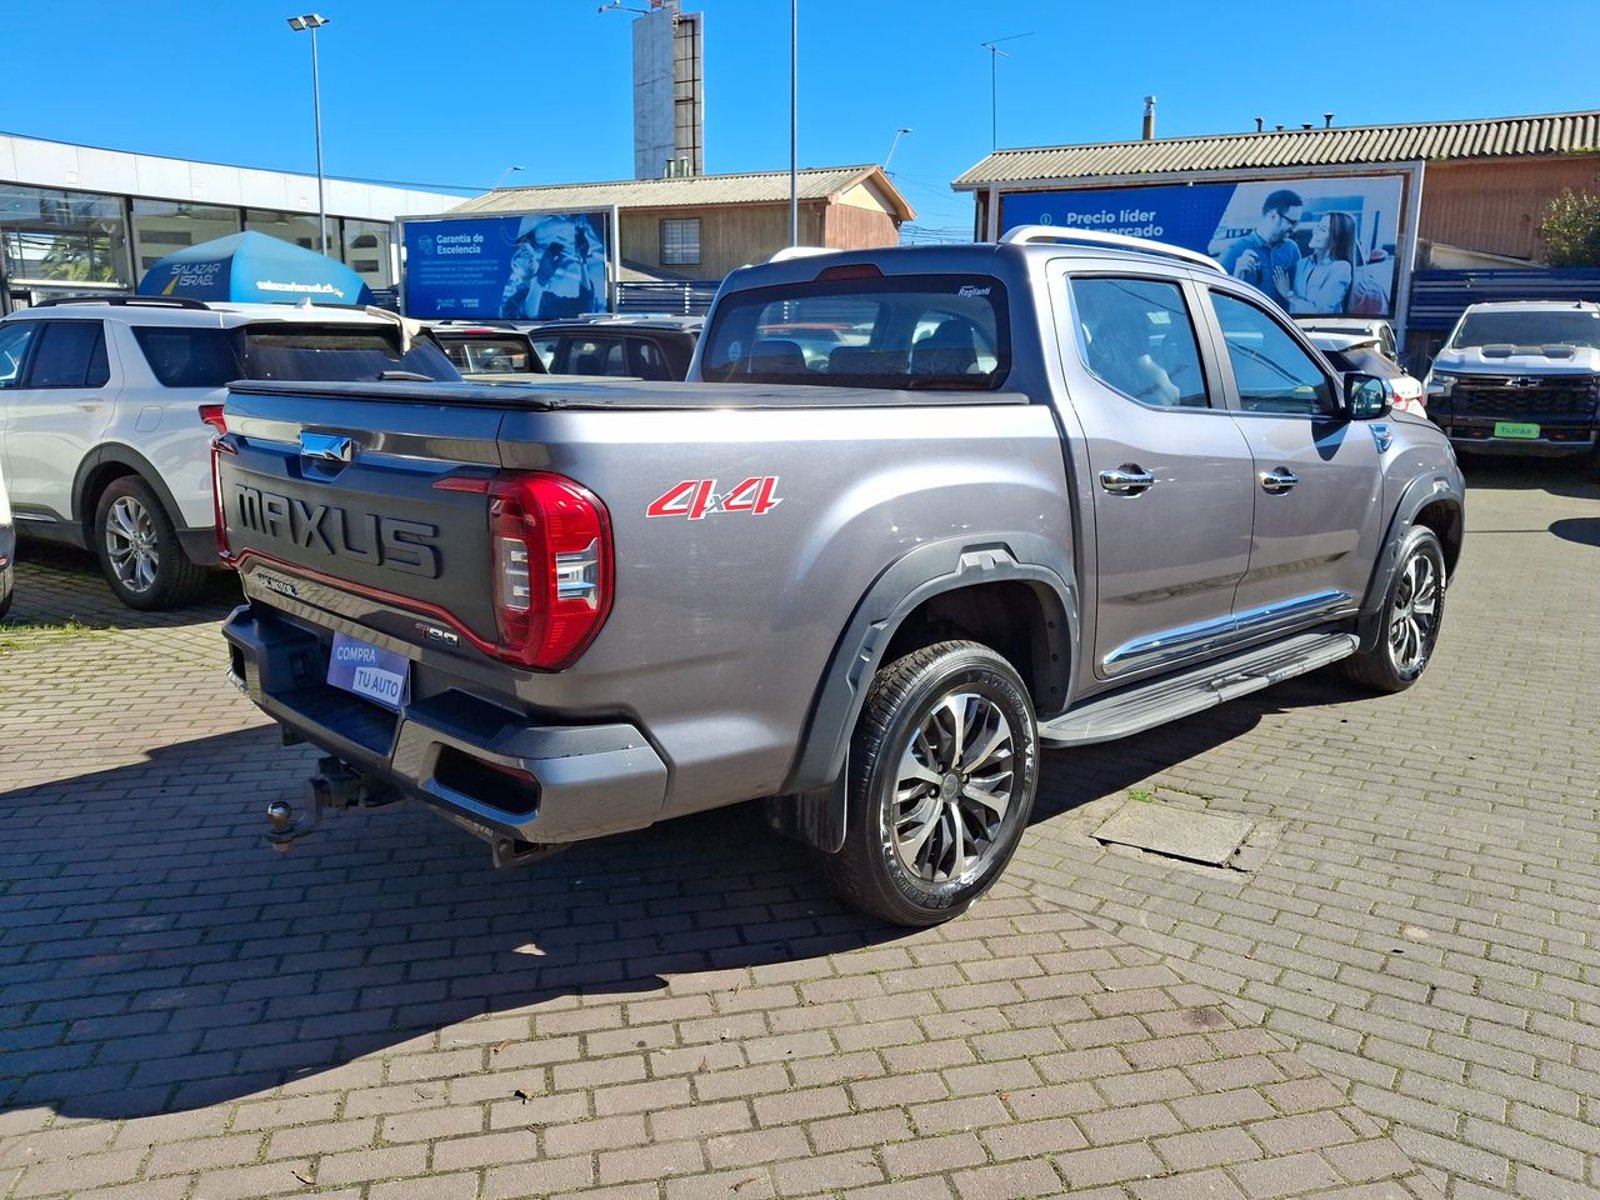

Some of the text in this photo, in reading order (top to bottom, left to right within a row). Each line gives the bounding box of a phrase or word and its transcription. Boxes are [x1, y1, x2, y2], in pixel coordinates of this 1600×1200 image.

[1067, 209, 1156, 224] Precio líder
[472, 233, 484, 243] de
[437, 244, 481, 255] Excelencia
[170, 263, 221, 275] SALAZAR
[179, 275, 214, 286] ISRAEL
[646, 475, 784, 521] 4x4
[235, 484, 440, 580] MAXUS
[336, 645, 376, 662] COMPRA
[357, 670, 399, 698] TU AUTO
